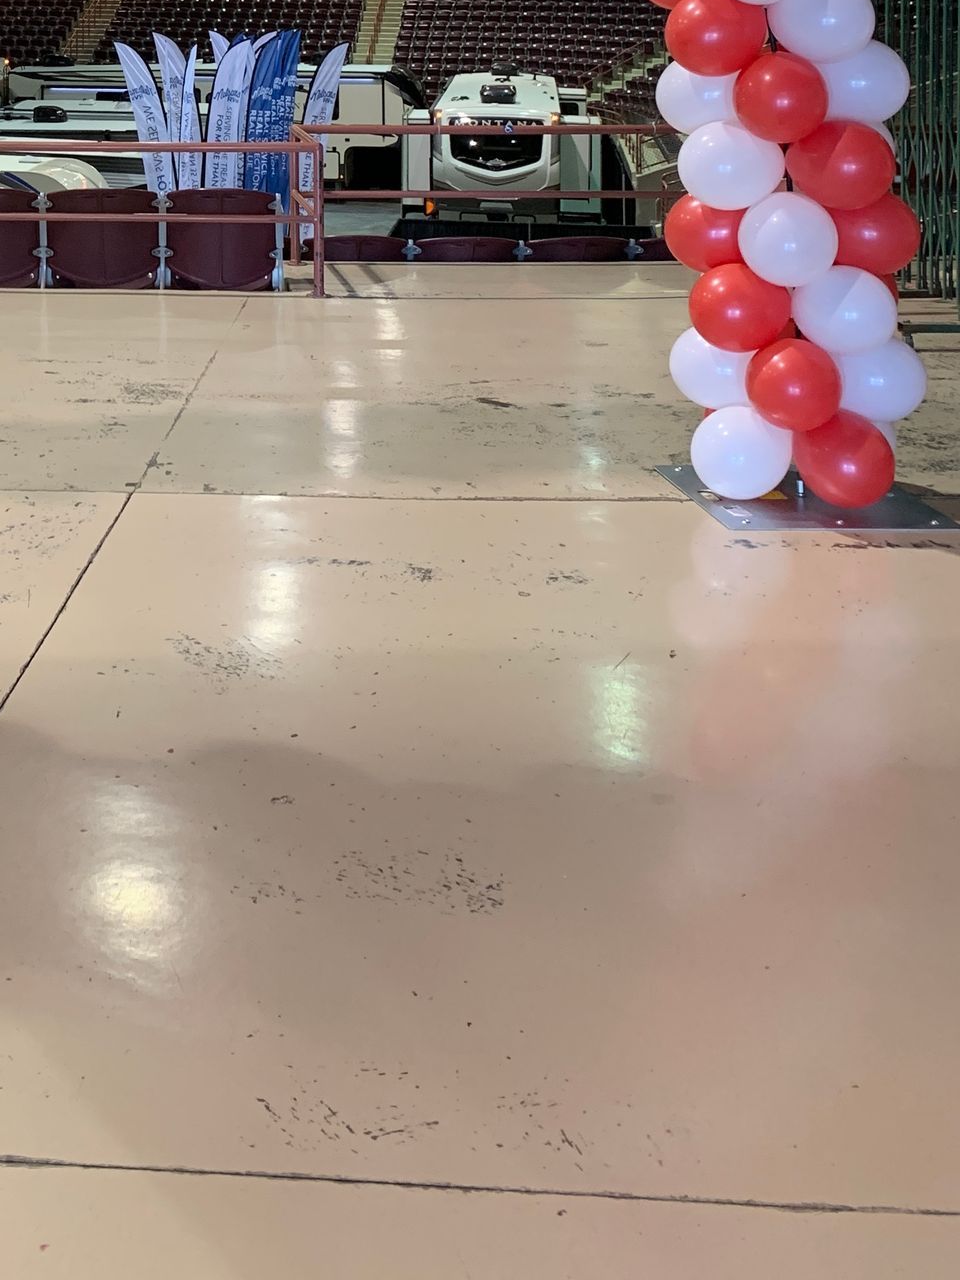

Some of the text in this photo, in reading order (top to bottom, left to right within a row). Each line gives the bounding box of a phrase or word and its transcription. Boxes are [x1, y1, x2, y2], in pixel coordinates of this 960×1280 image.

[215, 114, 224, 132] FOR
[223, 106, 233, 142] SERVING
[248, 109, 257, 134] REAL
[255, 110, 263, 135] REAL
[211, 162, 220, 187] THAN
[302, 162, 311, 187] THAN
